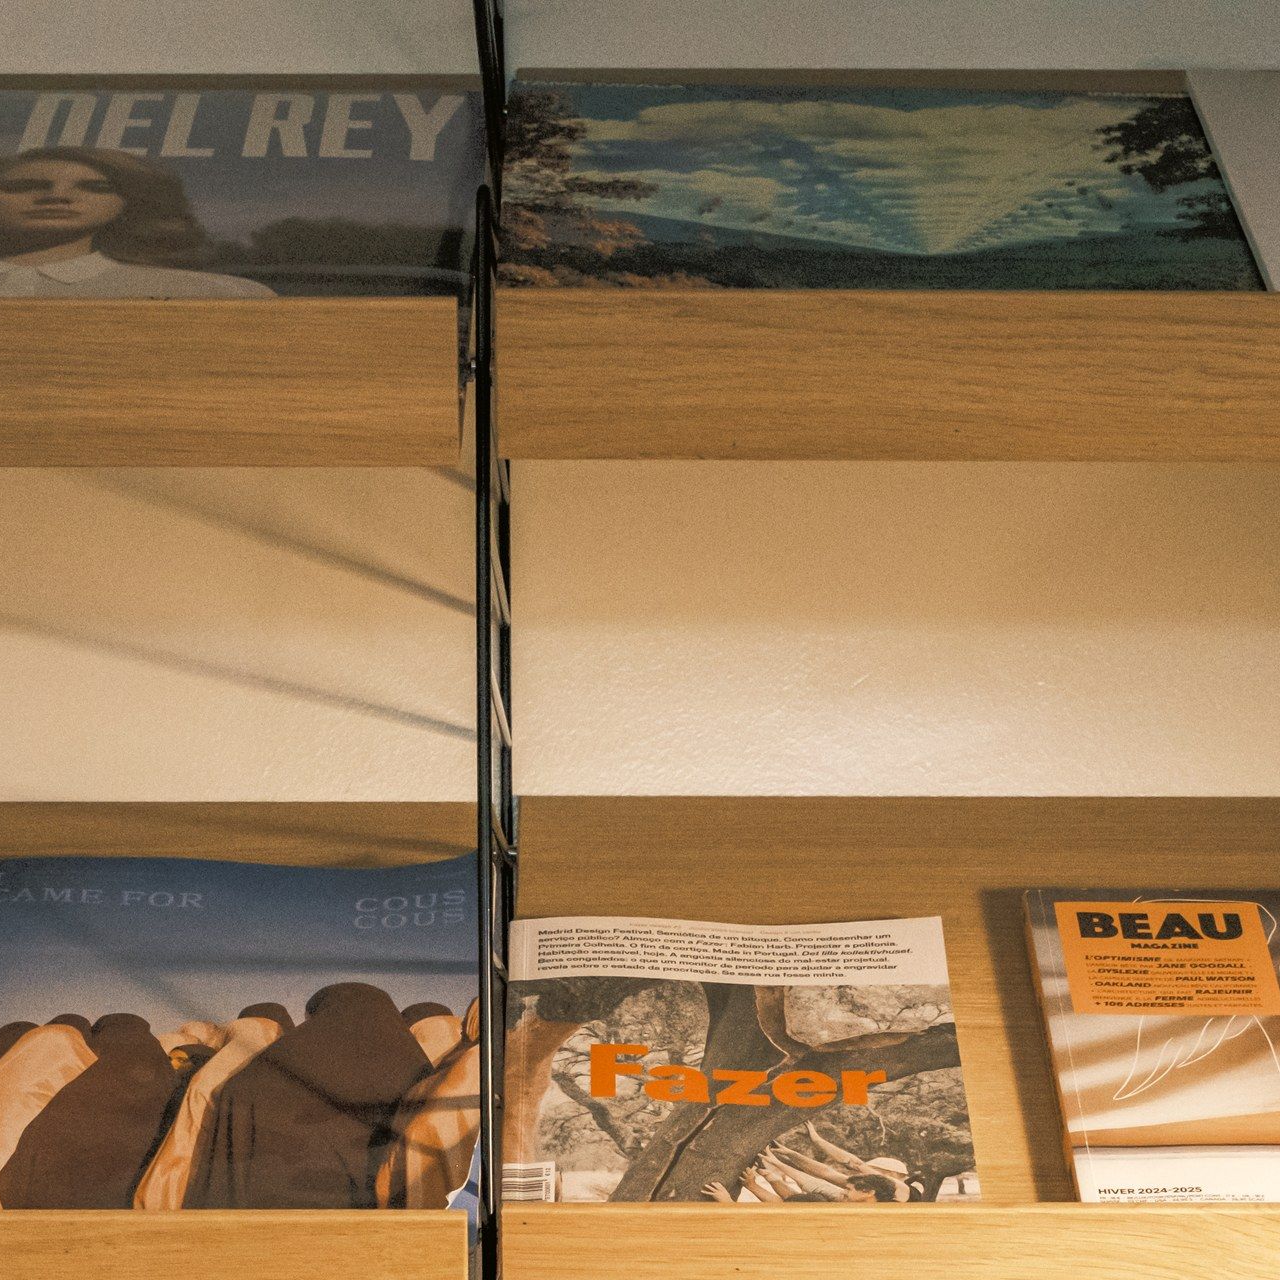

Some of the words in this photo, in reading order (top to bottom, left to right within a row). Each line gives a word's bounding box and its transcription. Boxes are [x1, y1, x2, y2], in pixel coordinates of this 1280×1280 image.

[17, 91, 217, 158] DEL
[241, 91, 464, 162] REY
[121, 890, 205, 909] FOR
[355, 889, 466, 913] COUS
[353, 908, 466, 930] COUS
[1076, 912, 1243, 940] BEAU
[538, 928, 573, 936] Madrid
[575, 928, 610, 936] Design
[613, 927, 653, 936] Festival.
[657, 930, 706, 939] Semiótica
[816, 934, 873, 942] redesenhar
[622, 936, 661, 944] Almoço
[590, 1043, 888, 1108] Fazer
[1138, 1186, 1202, 1195] 2024-2025
